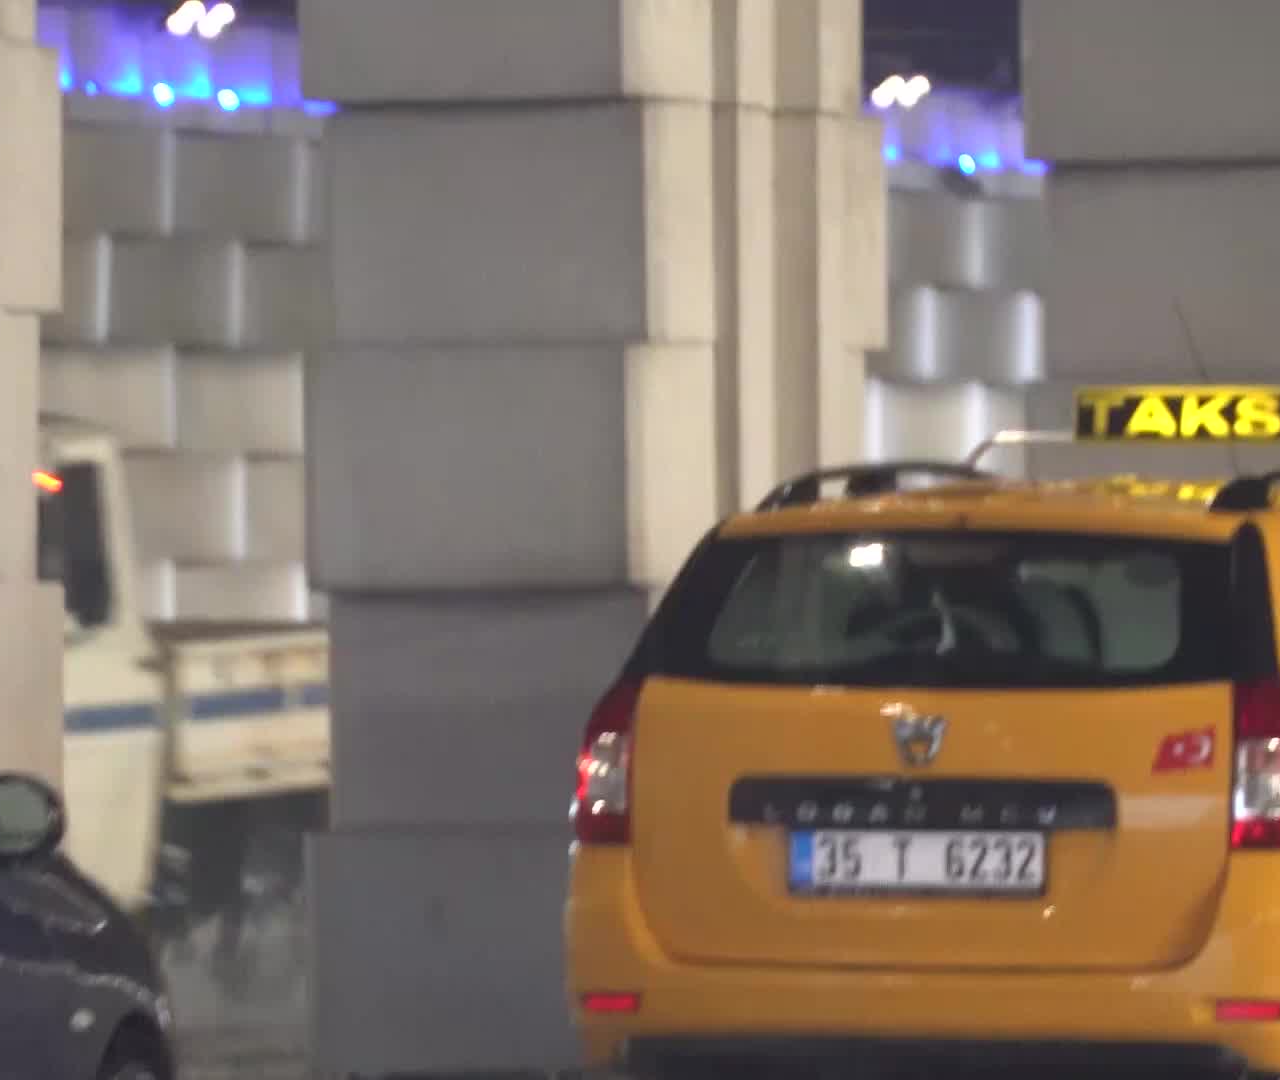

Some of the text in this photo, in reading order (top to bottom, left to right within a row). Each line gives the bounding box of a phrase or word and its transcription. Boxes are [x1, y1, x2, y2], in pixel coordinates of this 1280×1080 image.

[817, 834, 1039, 883] 35 T 6232
